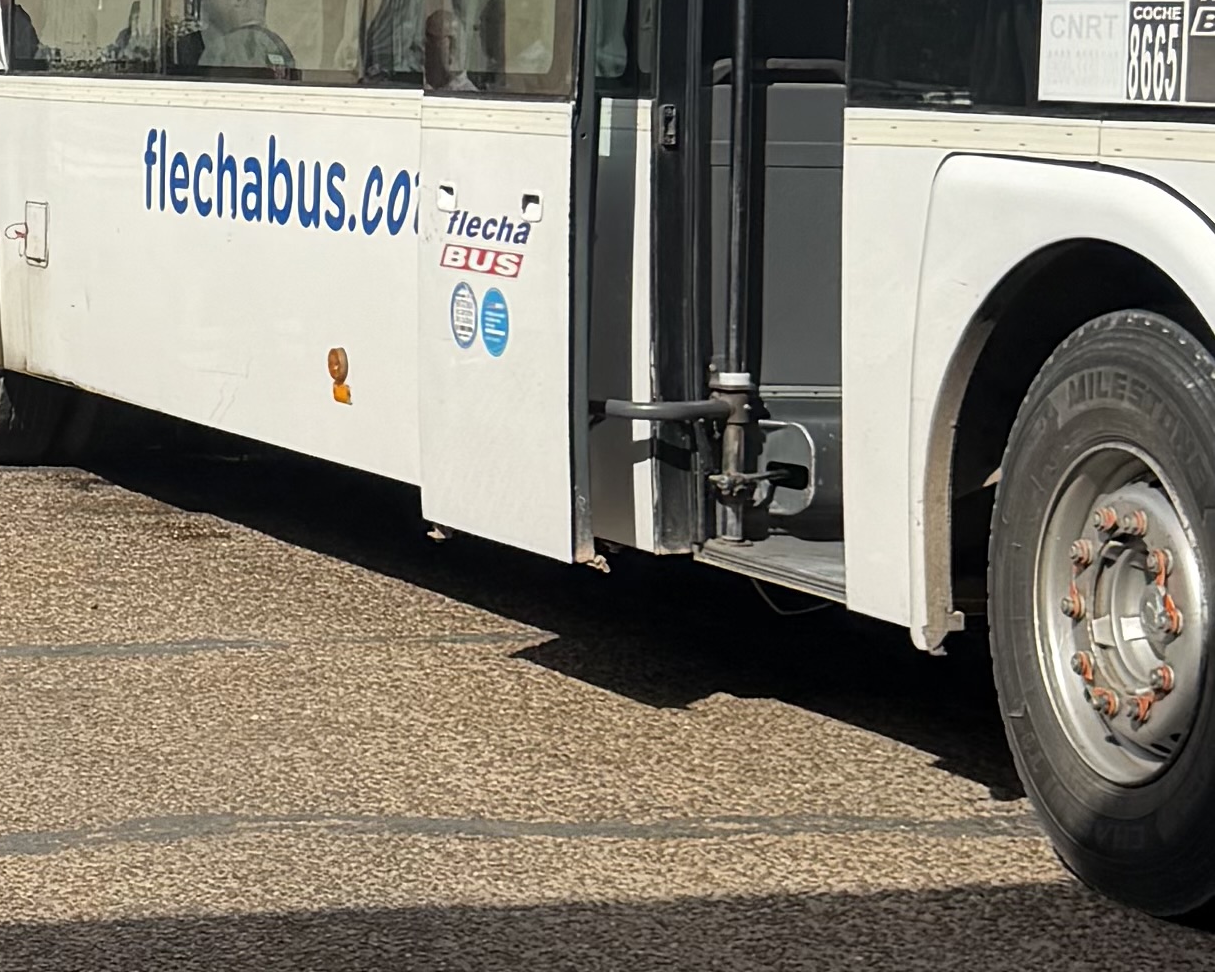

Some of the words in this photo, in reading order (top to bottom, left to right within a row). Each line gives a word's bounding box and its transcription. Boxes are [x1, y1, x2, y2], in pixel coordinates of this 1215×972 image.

[1050, 14, 1118, 40] CNRT
[1133, 6, 1182, 20] COCHE
[1128, 23, 1179, 101] 8665
[144, 128, 421, 236] flechabus.co
[446, 210, 532, 244] flecha
[442, 245, 520, 276] BUS
